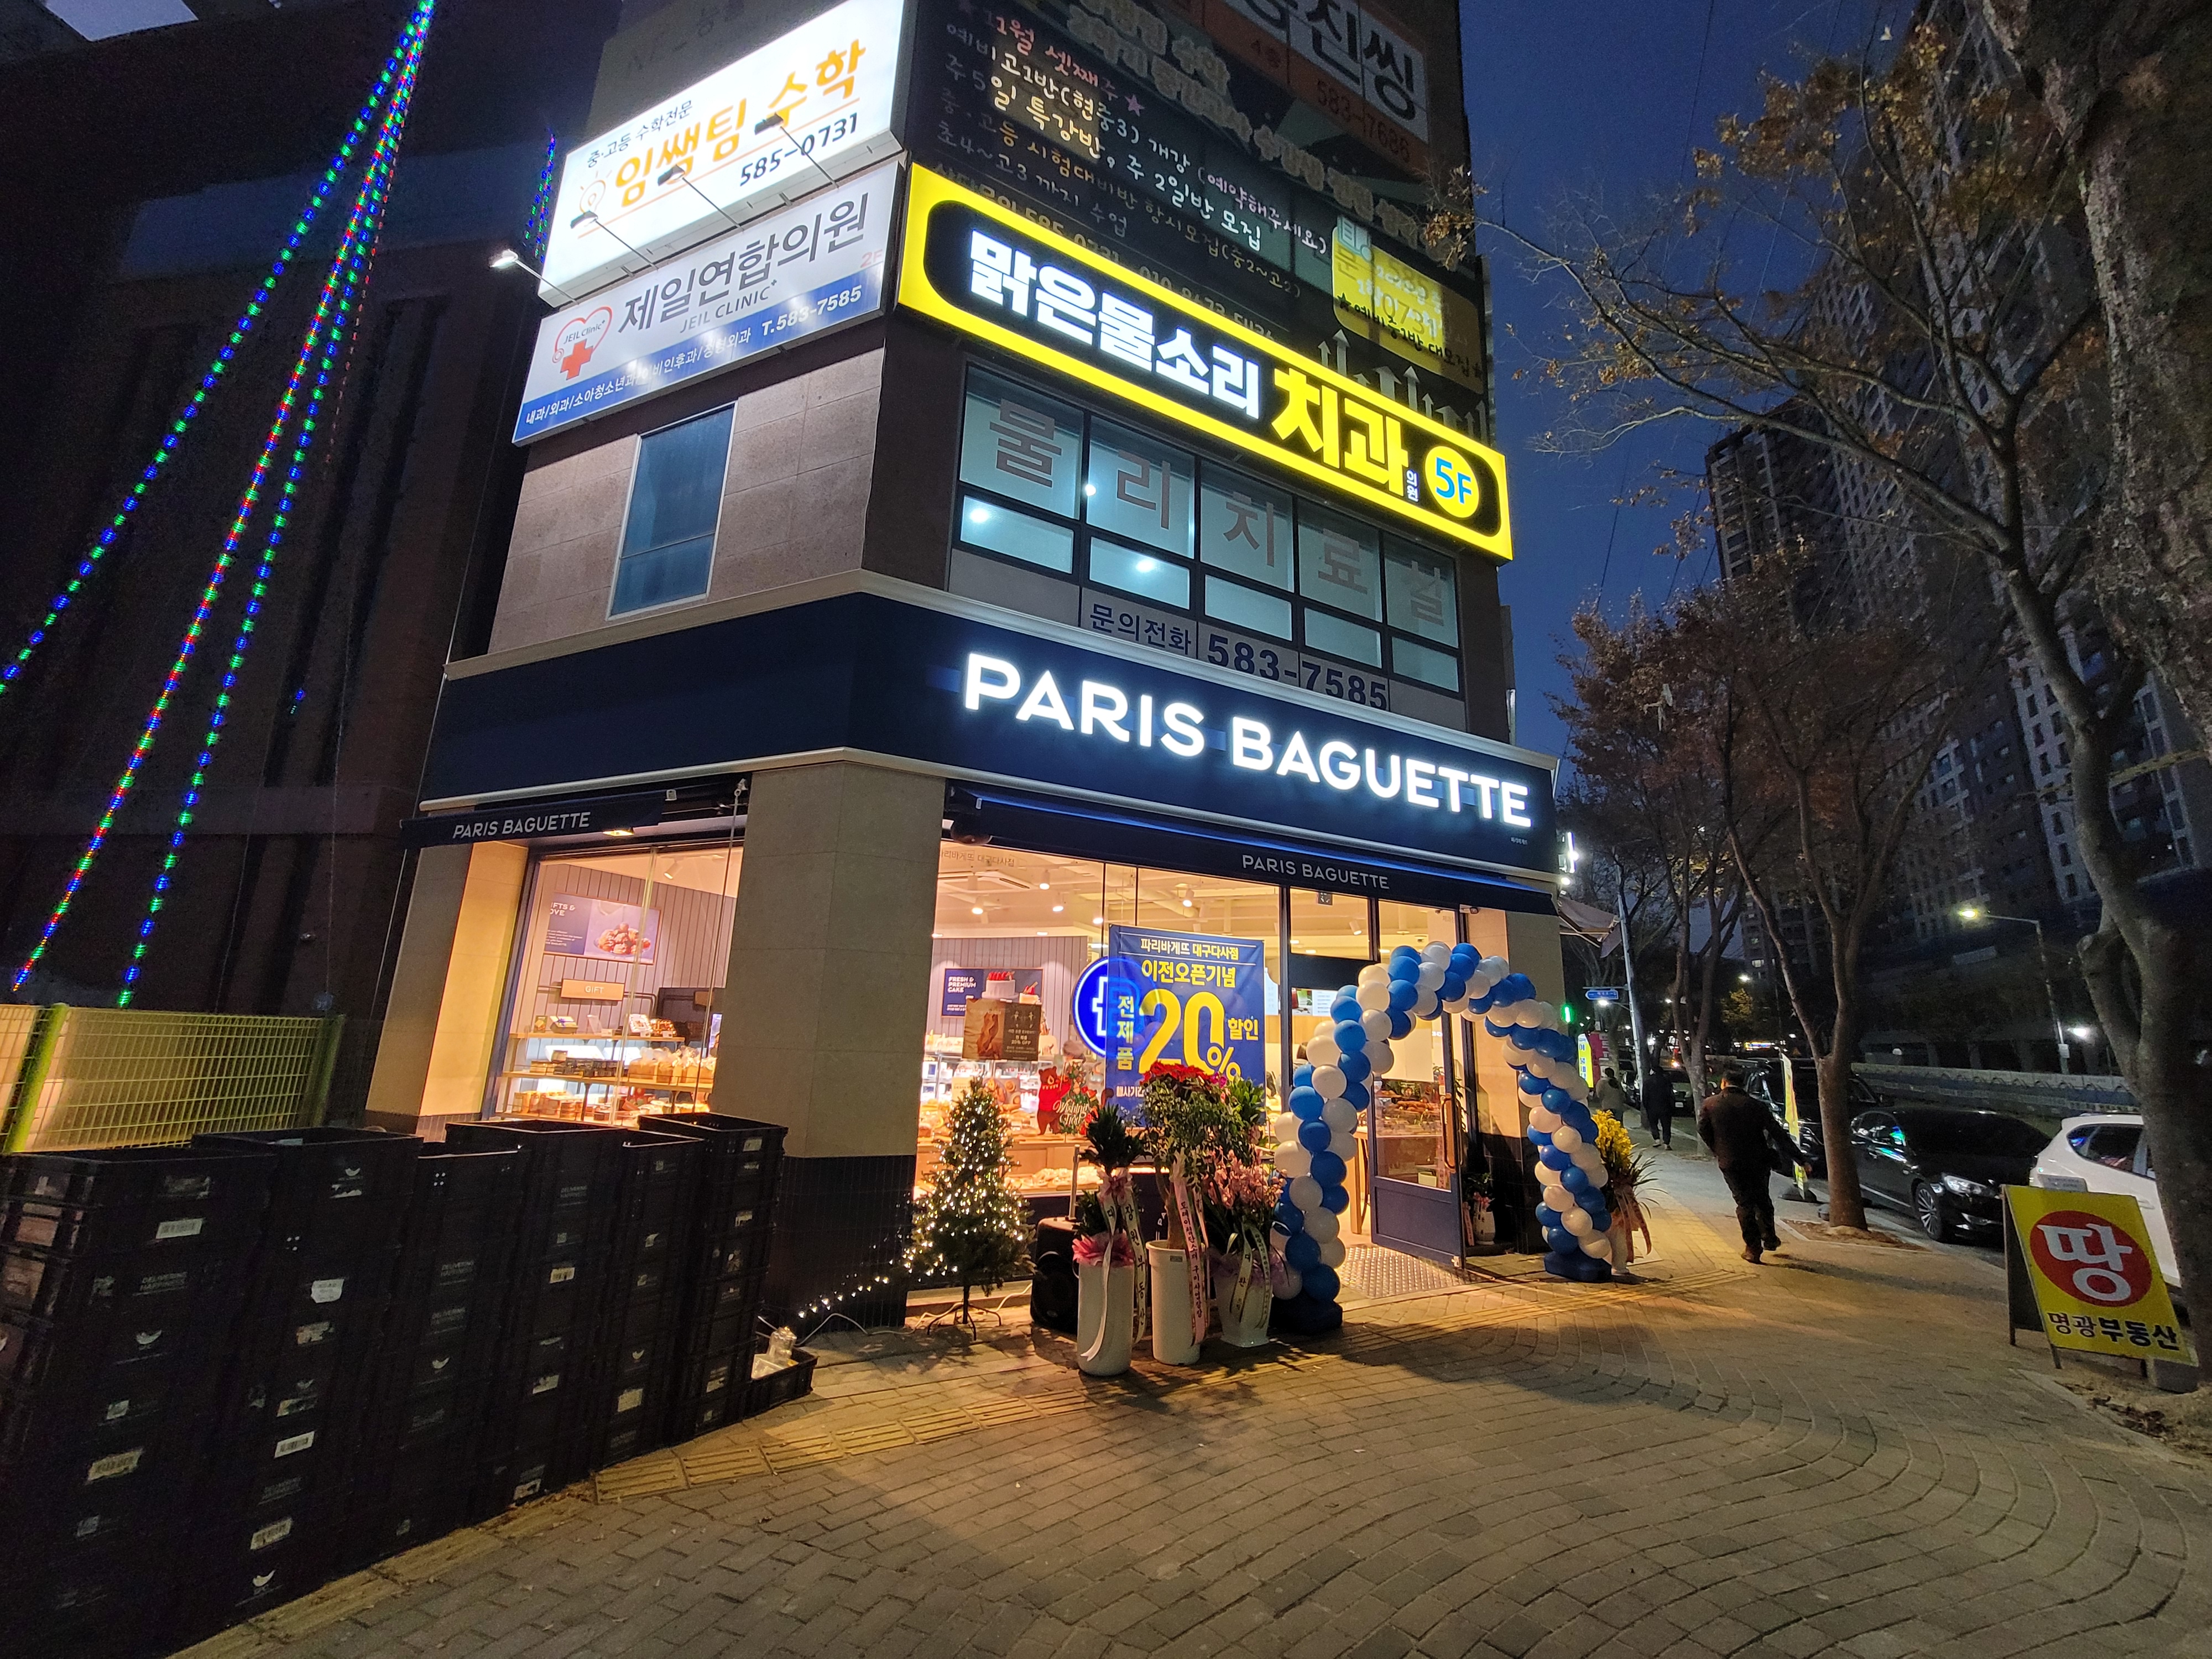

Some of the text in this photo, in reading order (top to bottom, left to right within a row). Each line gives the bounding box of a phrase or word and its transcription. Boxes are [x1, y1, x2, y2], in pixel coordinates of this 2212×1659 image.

[1045, 46, 1099, 87] 셋째
[1245, 0, 1416, 120] 진씽
[767, 38, 867, 127] 수학
[635, 100, 694, 143] 수학전문
[739, 112, 859, 187] 585-0731
[1149, 139, 1191, 173] 개강
[1220, 210, 1261, 252] 모집
[618, 192, 869, 334] 제일연합의원
[860, 249, 883, 269] 2F
[680, 285, 771, 333] JEIL CLINIC
[563, 323, 602, 345] JEIL Clinic
[971, 229, 1260, 420] 맑은물소리
[1271, 367, 1409, 498] 치과
[1406, 468, 1419, 503] 의원
[1436, 457, 1472, 505] 5F
[1089, 603, 1387, 711] 문의전화 583-7585
[966, 654, 1530, 826] PARIS BAGUETTE
[452, 811, 591, 839] PARIS BAGUETTE
[1242, 854, 1390, 889] PARIS BAGUETTE
[1140, 938, 1240, 961] 파리바게뜨 대구다사점
[585, 985, 605, 994] GIFT
[1141, 959, 1237, 989] 이전오픈기념
[1228, 1018, 1259, 1041] 할인
[2036, 1222, 2133, 1302] 땅
[2047, 1311, 2180, 1352] 명광부동산
